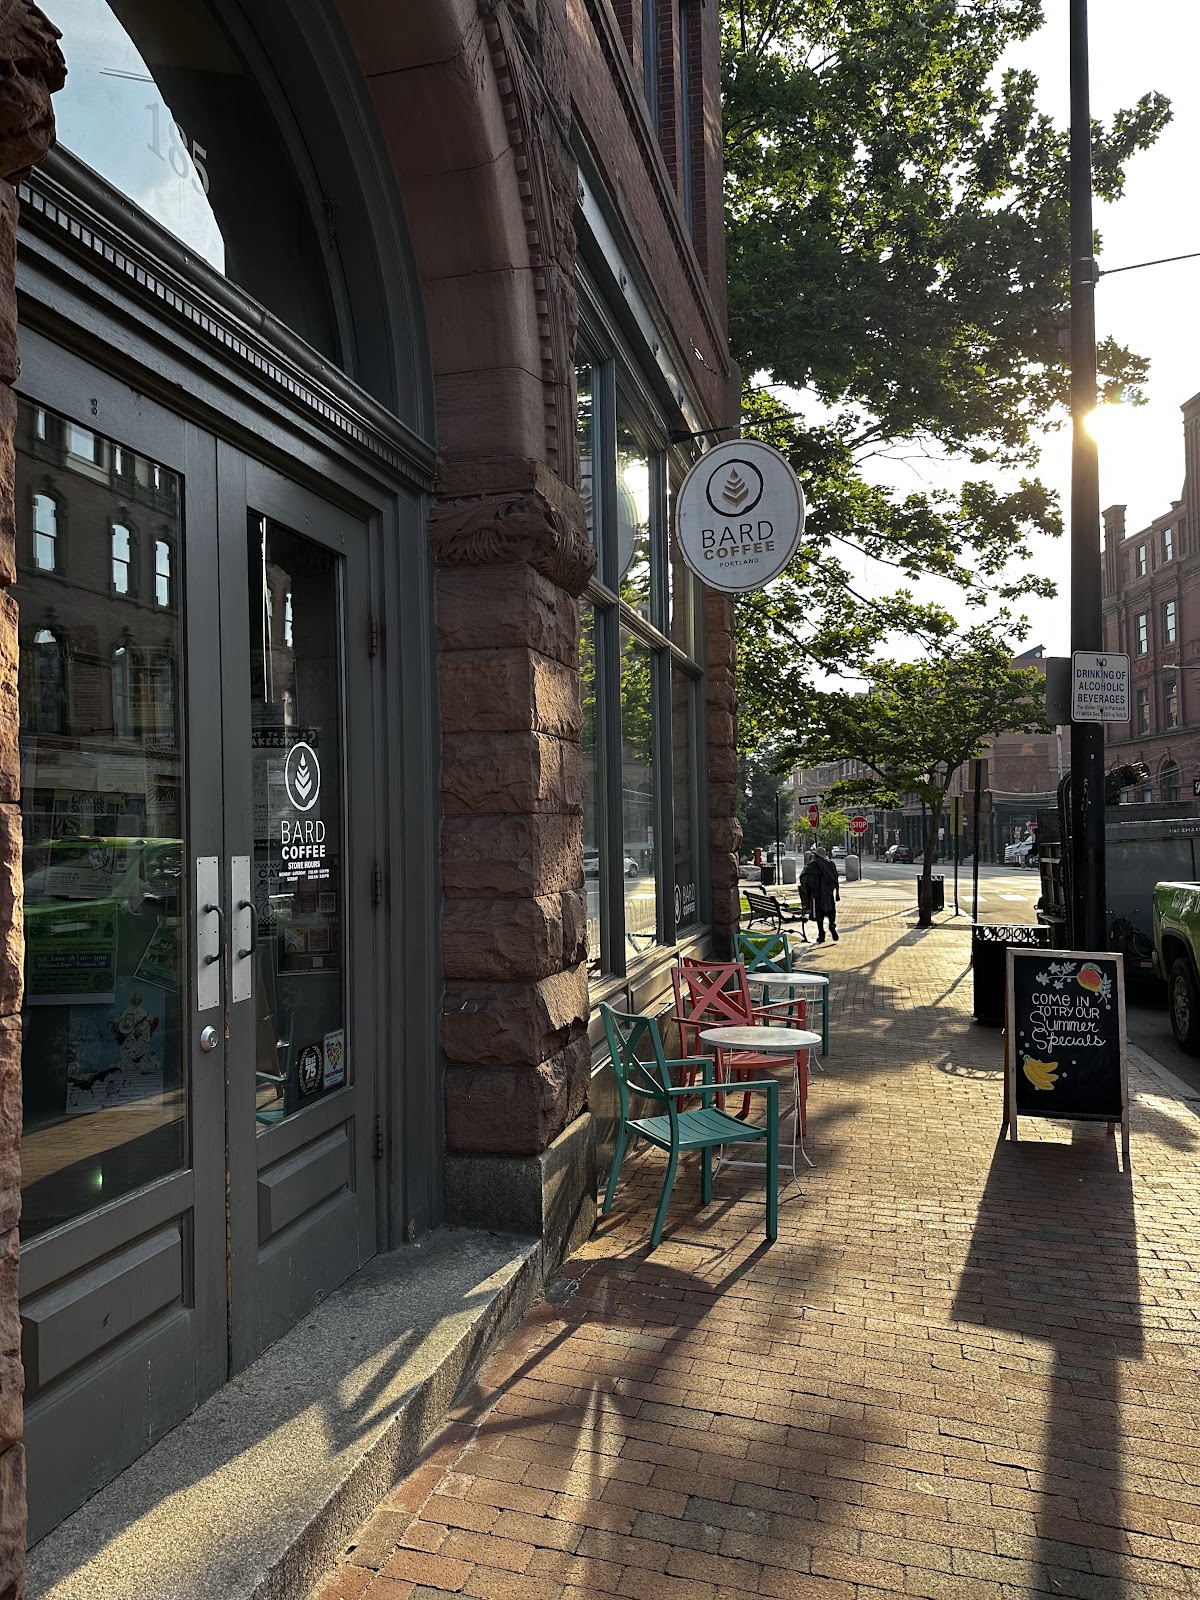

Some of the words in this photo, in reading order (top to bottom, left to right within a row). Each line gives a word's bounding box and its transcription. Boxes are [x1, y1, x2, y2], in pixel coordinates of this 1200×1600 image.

[144, 102, 210, 196] 185
[702, 520, 774, 549] BARD
[703, 540, 775, 560] COFFEE
[719, 557, 760, 568] PORTLAND
[1096, 657, 1107, 667] NO
[1076, 669, 1114, 679] DRINKING
[1116, 671, 1127, 680] OF
[1078, 681, 1125, 692] ALCOHOLIC
[1077, 693, 1125, 704] BEVERAGES
[71, 794, 105, 805] CIRCUS
[851, 821, 867, 829] STOP
[281, 820, 326, 845] BARD
[281, 844, 326, 860] COFFEE
[287, 861, 304, 870] STORE
[304, 860, 321, 869] HOURS
[683, 883, 695, 904] BARD
[1076, 994, 1090, 1007] IN
[1076, 1006, 1100, 1019] OUR
[1030, 1010, 1100, 1033] Summer
[1031, 1026, 1107, 1054] Specials
[305, 1063, 317, 1080] 75
